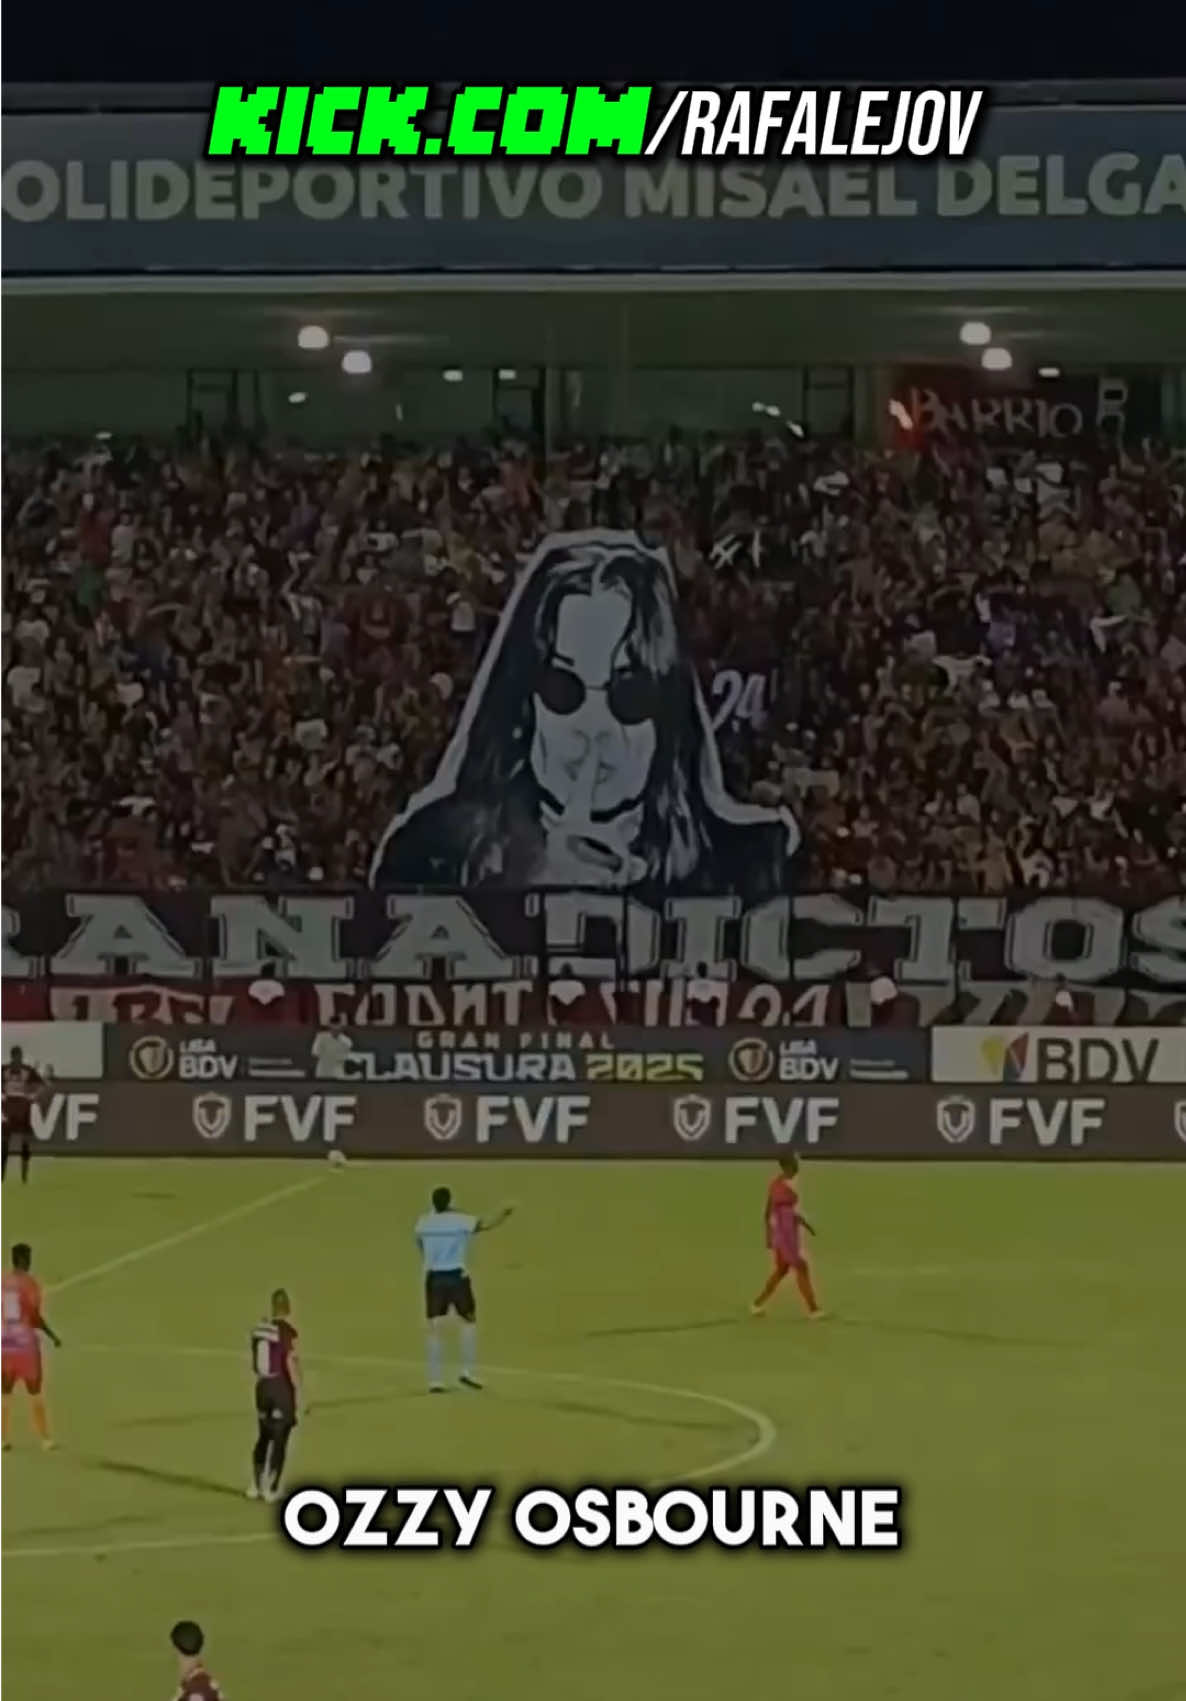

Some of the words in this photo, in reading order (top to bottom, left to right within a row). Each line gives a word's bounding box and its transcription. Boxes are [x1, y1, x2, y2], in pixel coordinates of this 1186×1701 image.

[624, 155, 918, 219] MISAEL
[416, 1031, 499, 1049] GRAN
[519, 1031, 615, 1050] FINAL
[1036, 1037, 1159, 1085] BDV
[178, 1054, 238, 1079] BDV
[343, 1052, 577, 1082] CLAUSURA
[585, 1053, 704, 1082] 2025
[778, 1056, 839, 1081] BDV
[244, 1095, 358, 1142] FVF
[475, 1095, 591, 1143] FVF
[725, 1097, 839, 1144] FVF
[988, 1098, 1105, 1146] FVF
